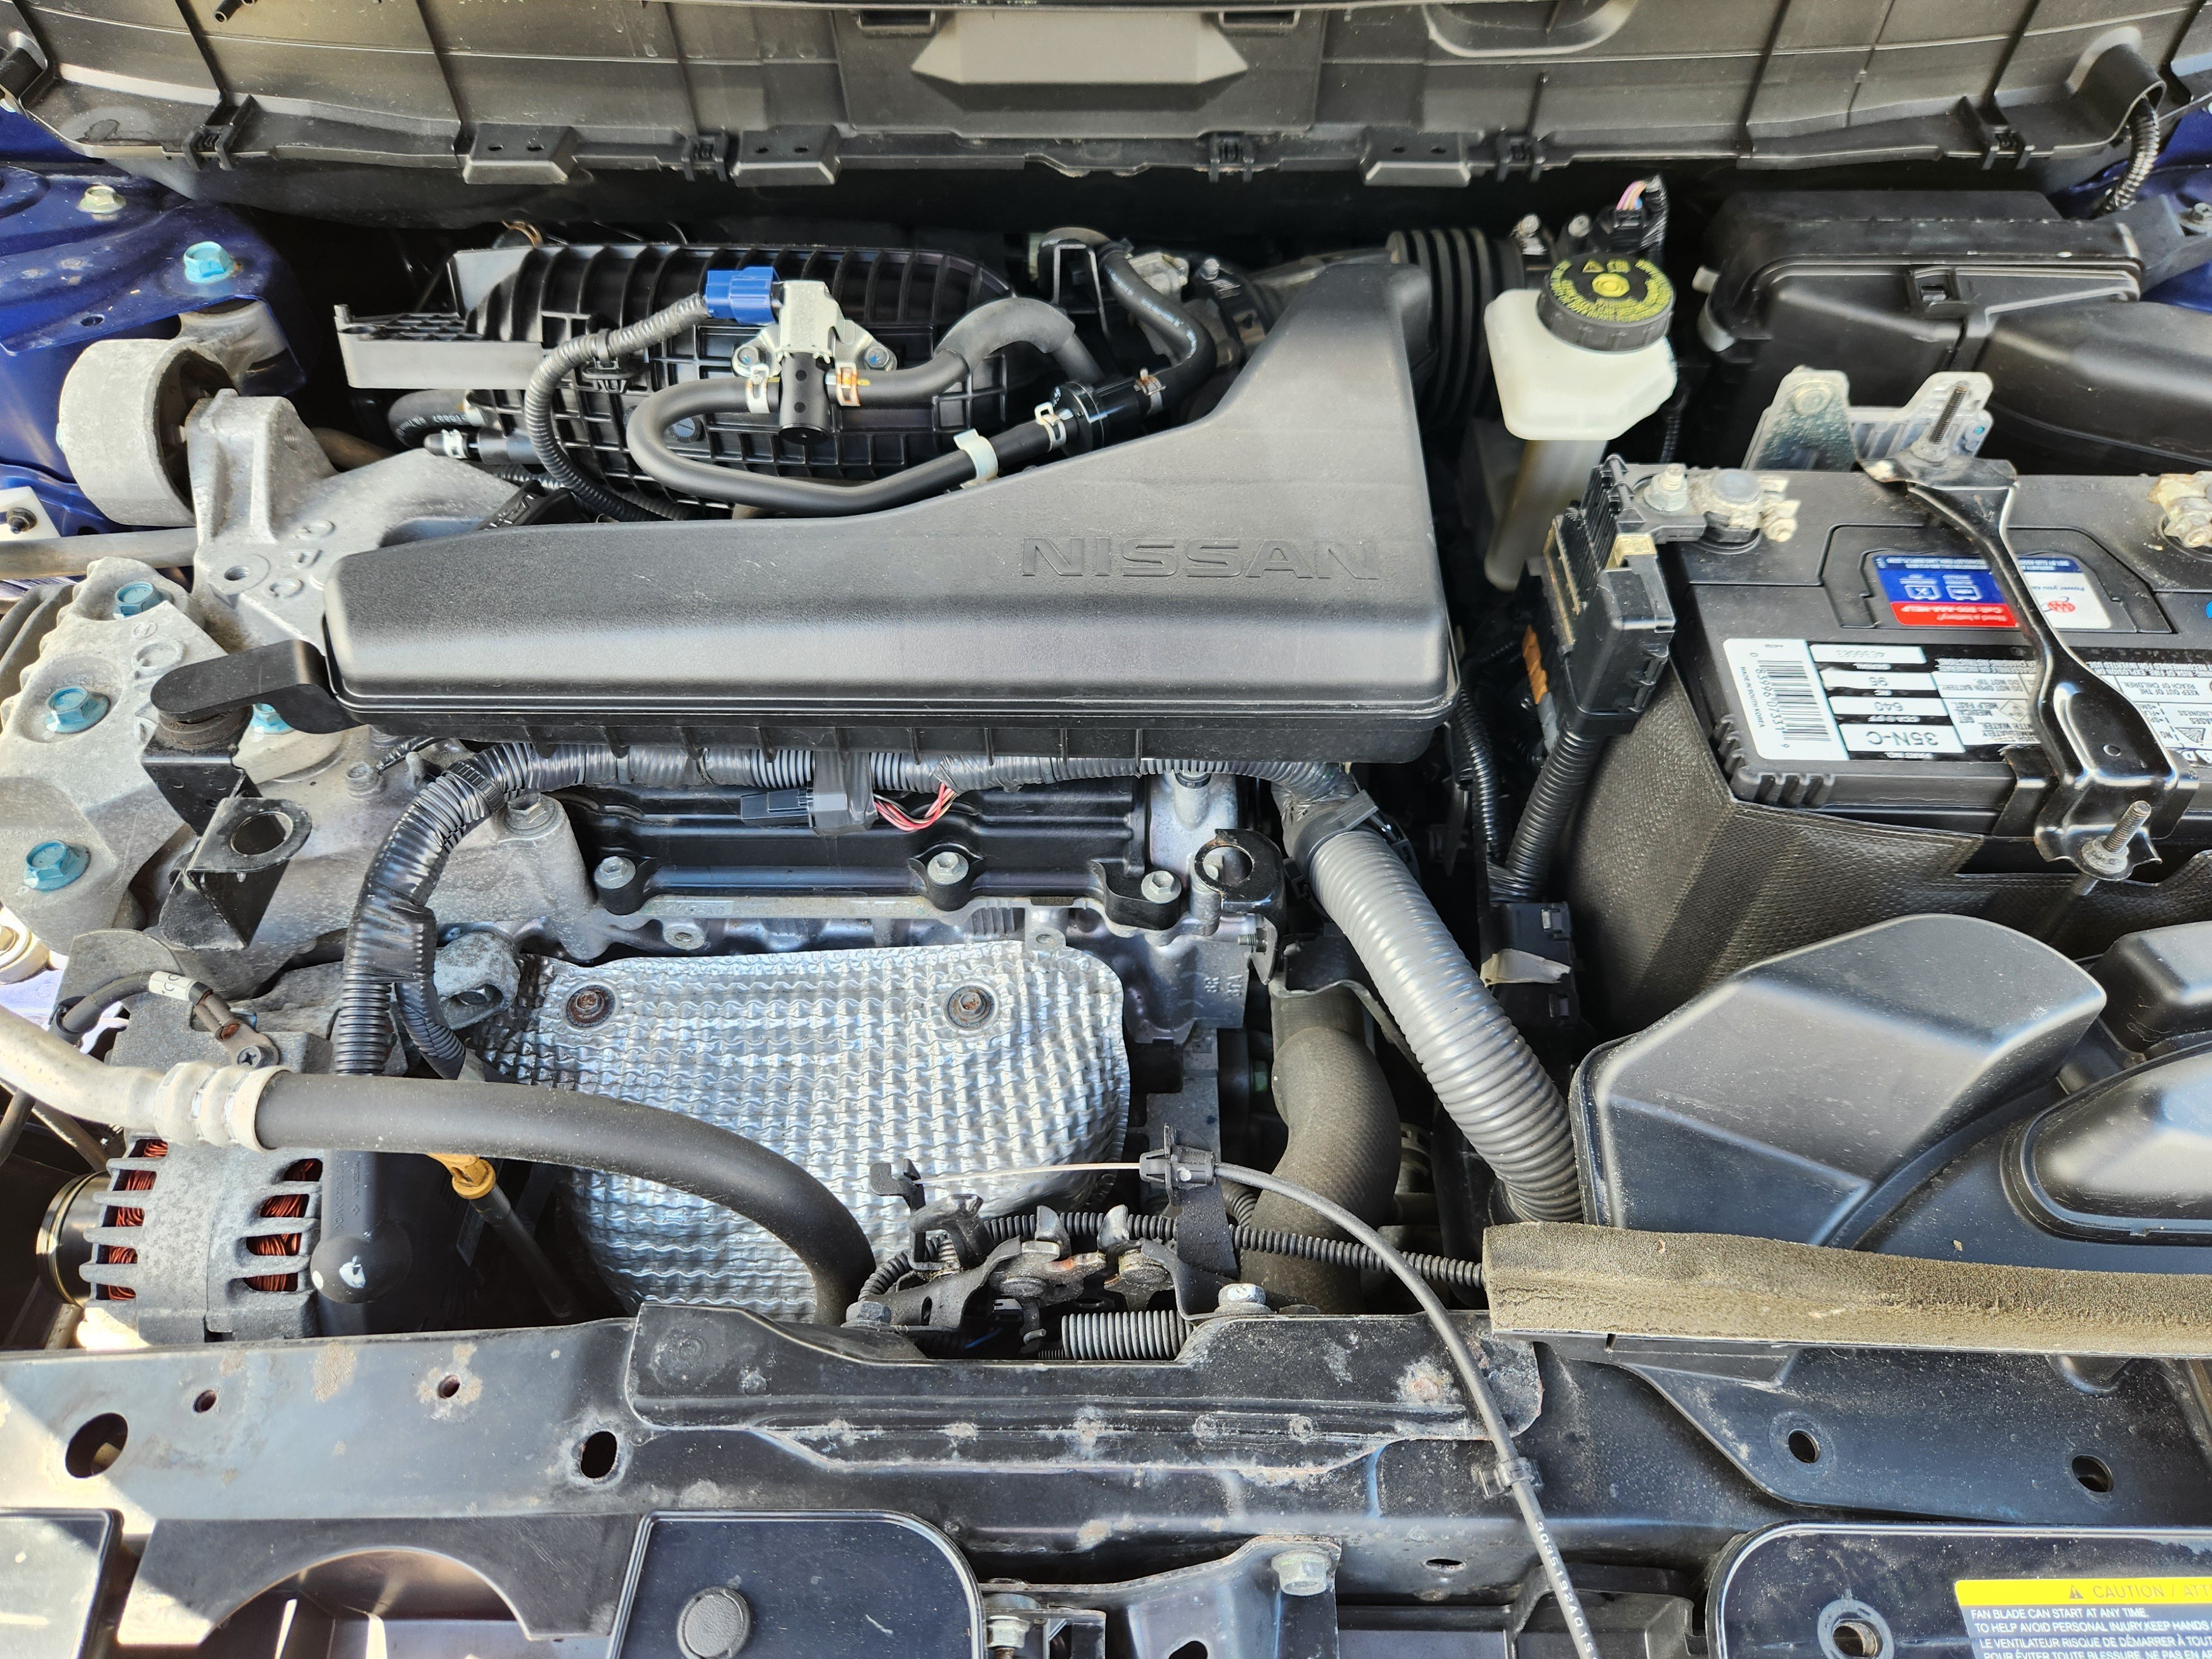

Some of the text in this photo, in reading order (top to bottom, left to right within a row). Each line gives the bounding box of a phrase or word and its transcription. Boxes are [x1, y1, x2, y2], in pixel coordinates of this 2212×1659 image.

[1021, 538, 1380, 579] NISSAN
[1869, 677, 1888, 686] 95
[1740, 667, 1750, 681] MADE
[1747, 689, 1759, 707] SOUTH
[1754, 708, 1765, 728] KOREA
[1756, 669, 1773, 697] 83996
[1766, 701, 1785, 730] 07331
[1874, 701, 1903, 711] 640
[1865, 731, 1938, 745] 35N-C
[2093, 1585, 2165, 1598] CAUTION
[2184, 1584, 2212, 1597] ATT
[1970, 1608, 2150, 1619] FAN BLADE CAN START AT ANY TIME.
[1974, 1623, 1990, 1633] TO
[1991, 1623, 2017, 1632] HELP
[2020, 1623, 2051, 1632] AVOID
[2052, 1622, 2109, 1632] PERSONAL
[2172, 1620, 2210, 1631] HANDS
[1980, 1639, 1993, 1648] LE
[1993, 1638, 2060, 1648] VENTILATEUR
[2062, 1637, 2103, 1648] RISQUE
[2103, 1637, 2118, 1648] DE
[2122, 1634, 2178, 1647] DÉMARRER
[2177, 1633, 2187, 1647] À
[2016, 1649, 2049, 1659] ÉVITER
[2145, 1650, 2161, 1659] NE
[2162, 1650, 2183, 1659] PAS
[2184, 1650, 2200, 1659] EN
